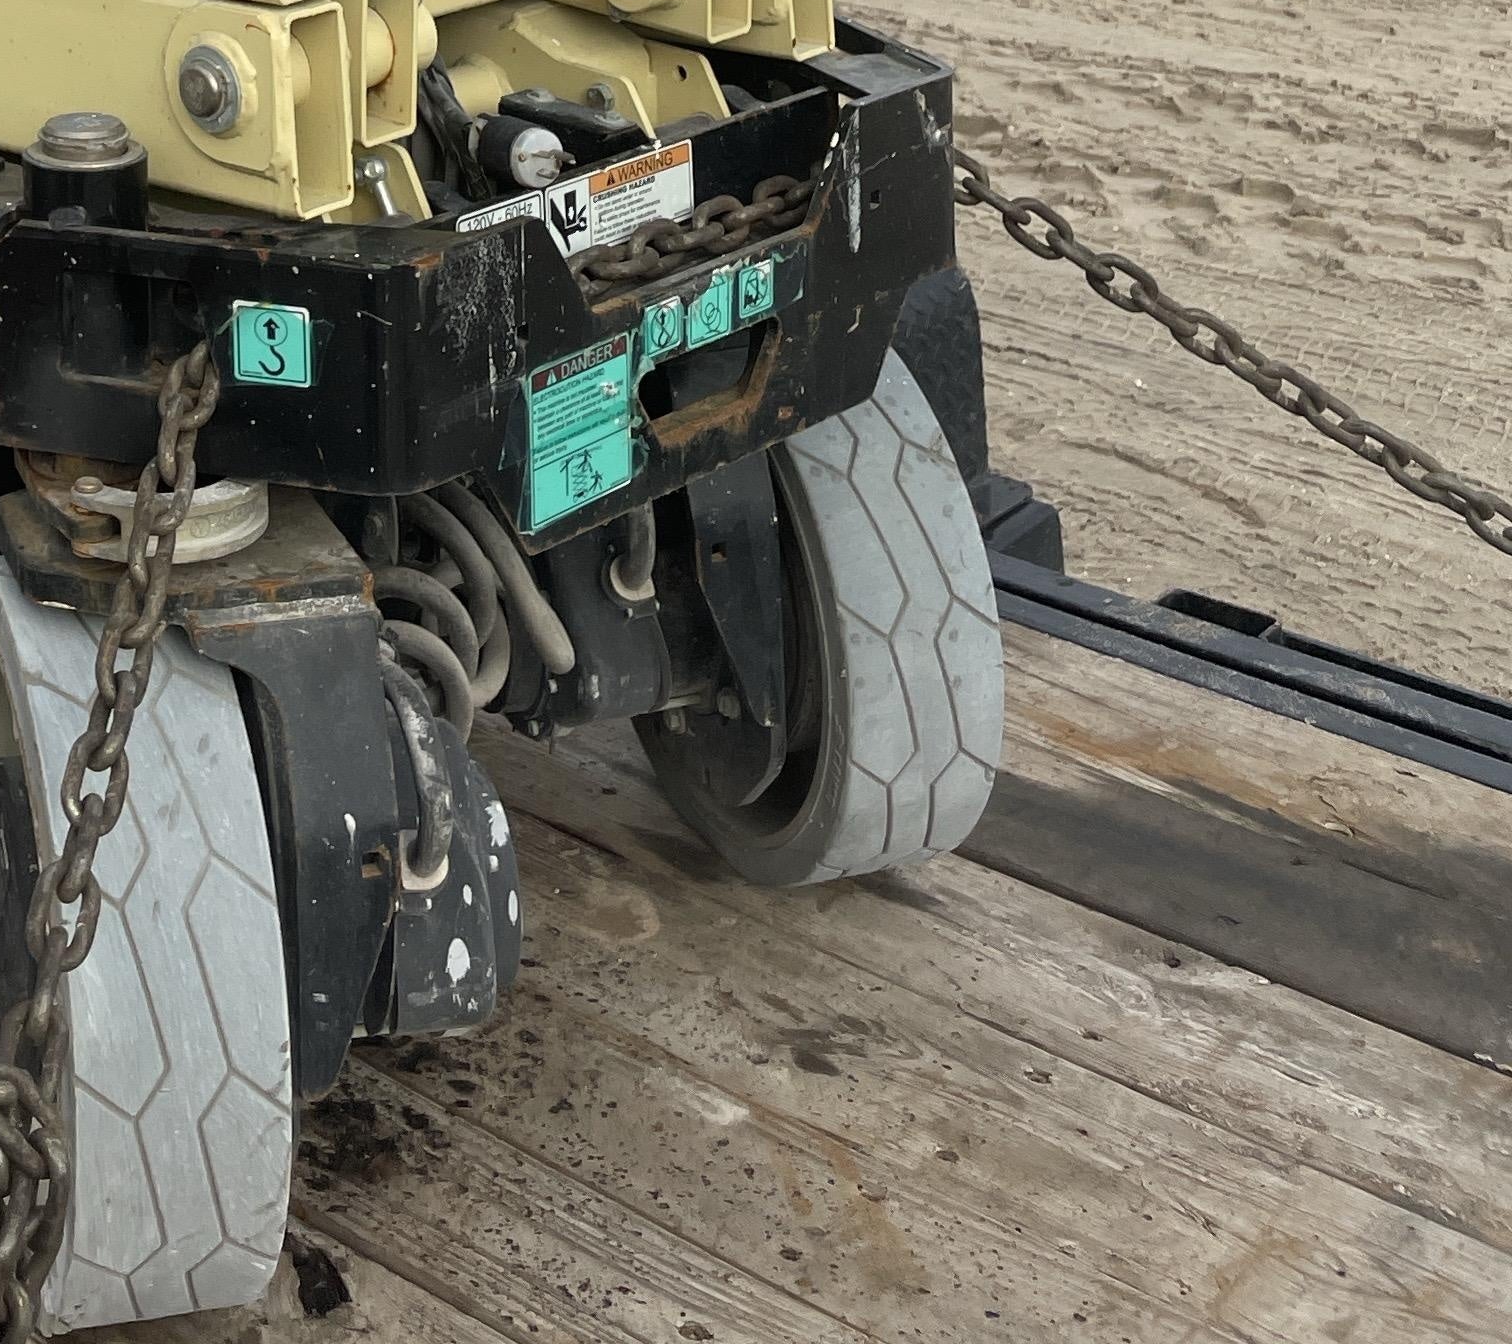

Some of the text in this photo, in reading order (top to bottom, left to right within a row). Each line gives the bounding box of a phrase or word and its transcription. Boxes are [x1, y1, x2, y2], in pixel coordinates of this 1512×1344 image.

[618, 151, 674, 182] WARNING
[467, 212, 495, 230] 120V
[504, 202, 533, 220] 60Hz
[560, 343, 614, 379] DANGER
